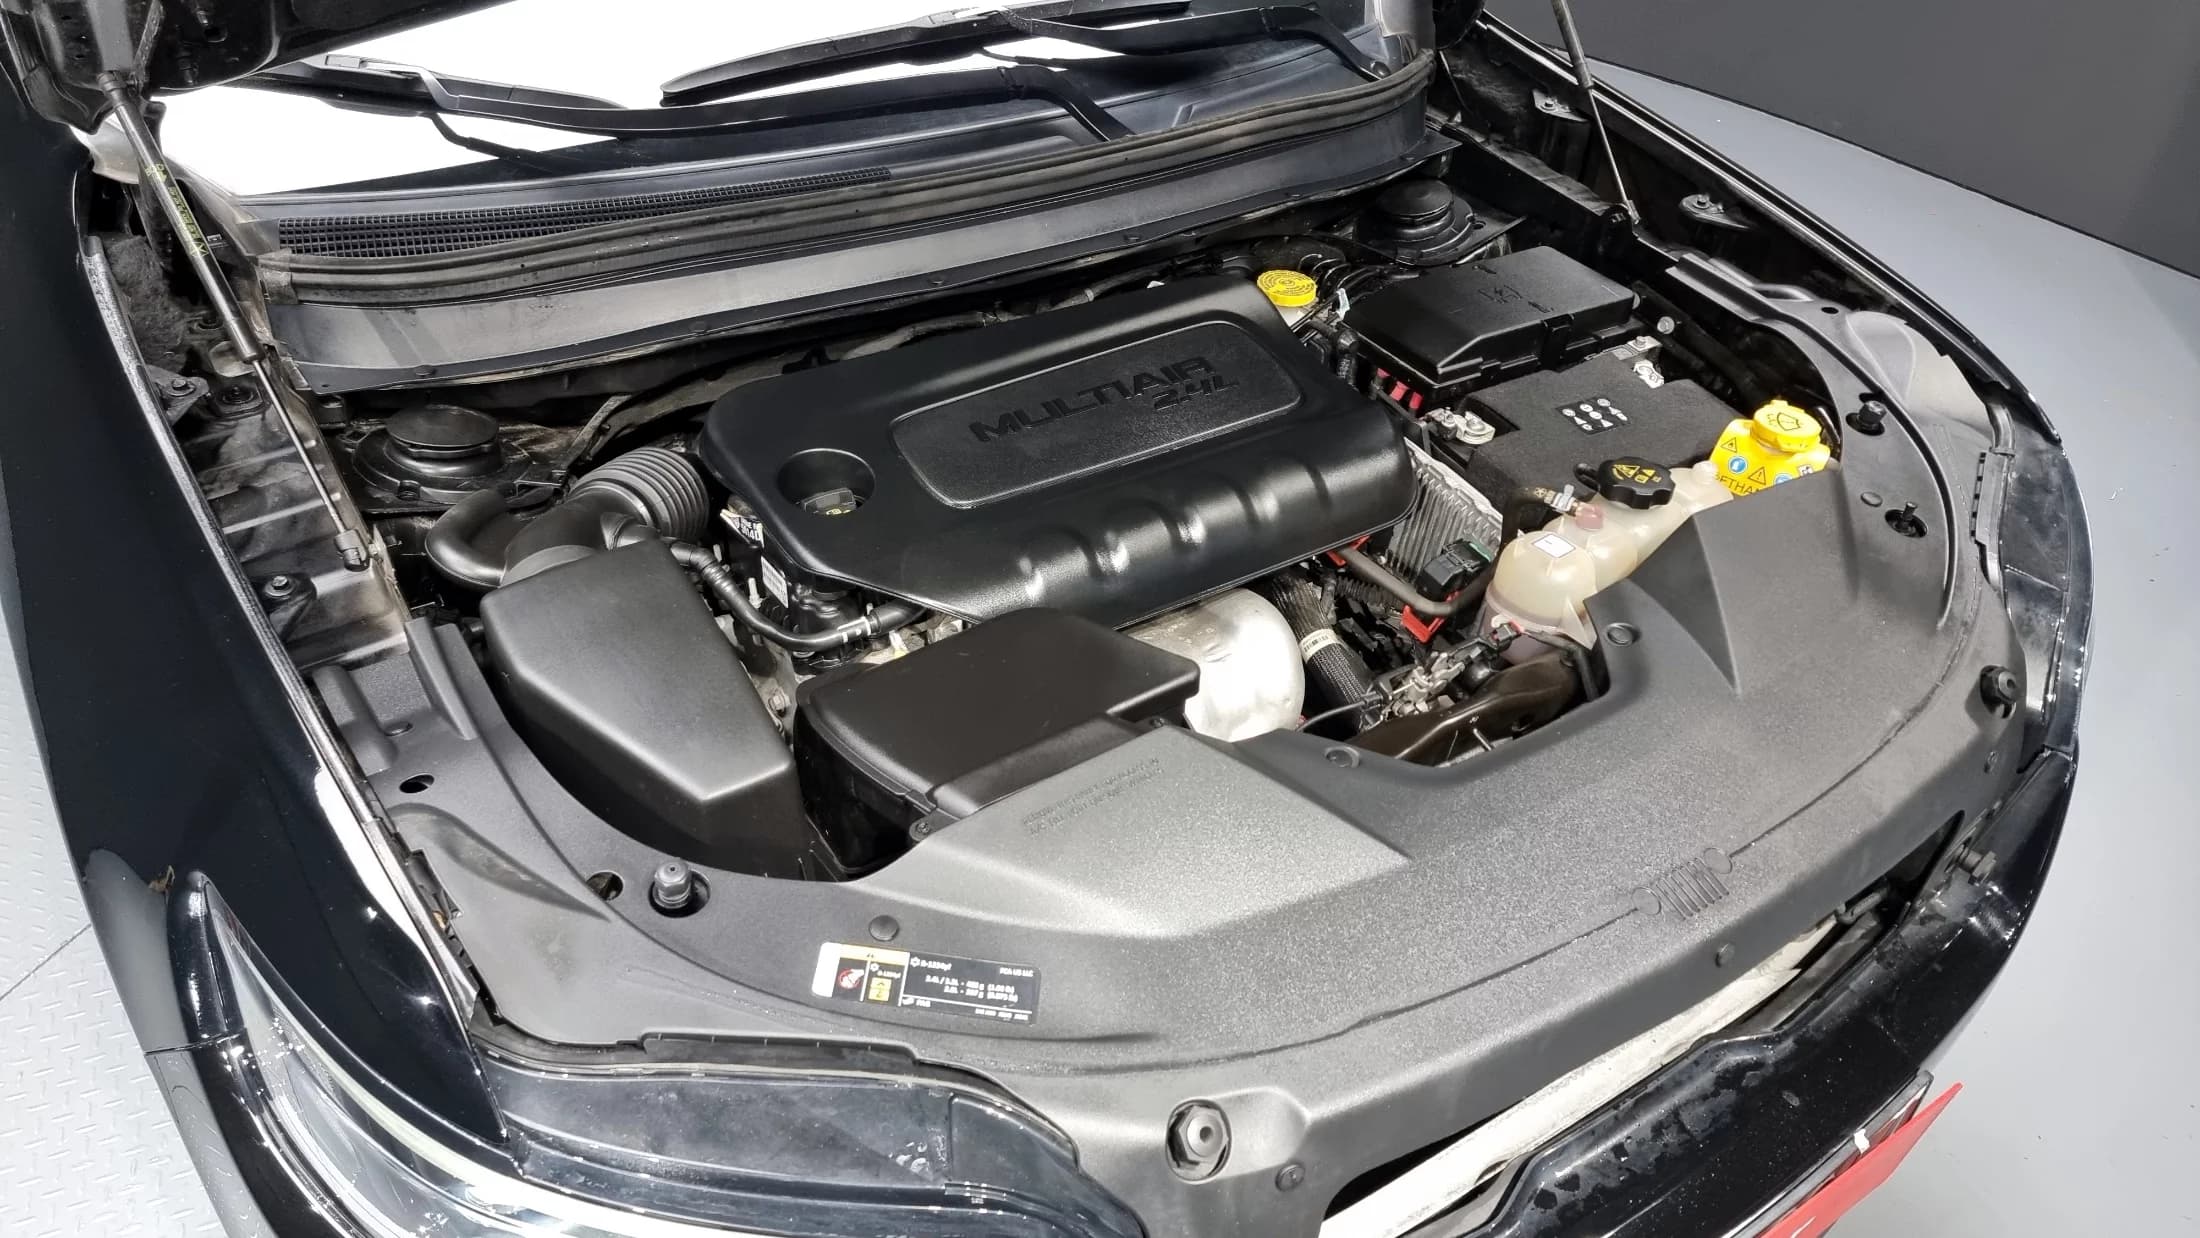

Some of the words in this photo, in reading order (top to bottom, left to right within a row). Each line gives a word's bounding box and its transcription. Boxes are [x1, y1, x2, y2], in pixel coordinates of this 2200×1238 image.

[968, 356, 1217, 443] MULTIAIR
[1154, 374, 1239, 411] 2.4L
[999, 967, 1012, 975] FCA
[1022, 969, 1034, 977] LLC
